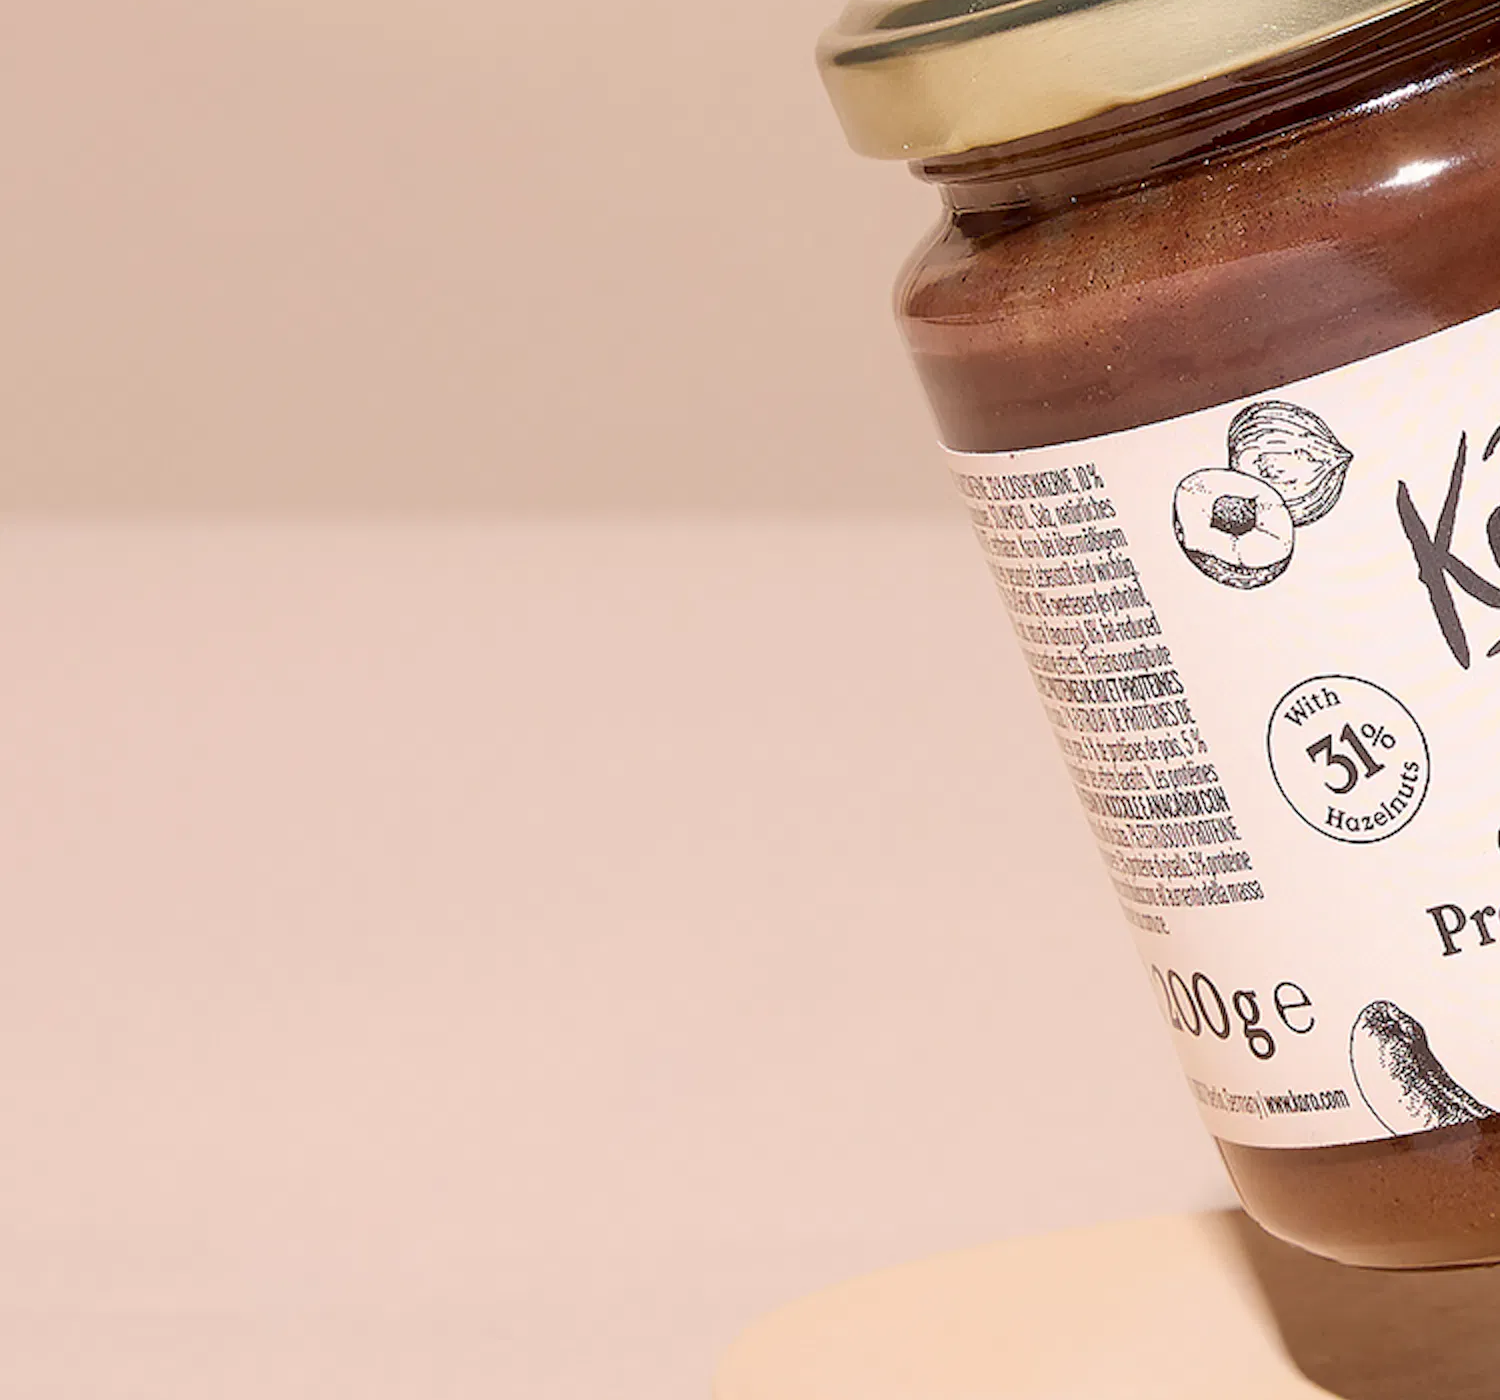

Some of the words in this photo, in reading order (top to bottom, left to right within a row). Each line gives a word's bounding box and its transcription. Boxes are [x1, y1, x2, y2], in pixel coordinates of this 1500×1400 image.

[1284, 687, 1342, 726] With
[1306, 722, 1396, 794] 31%
[1325, 760, 1420, 832] Hazelnuts
